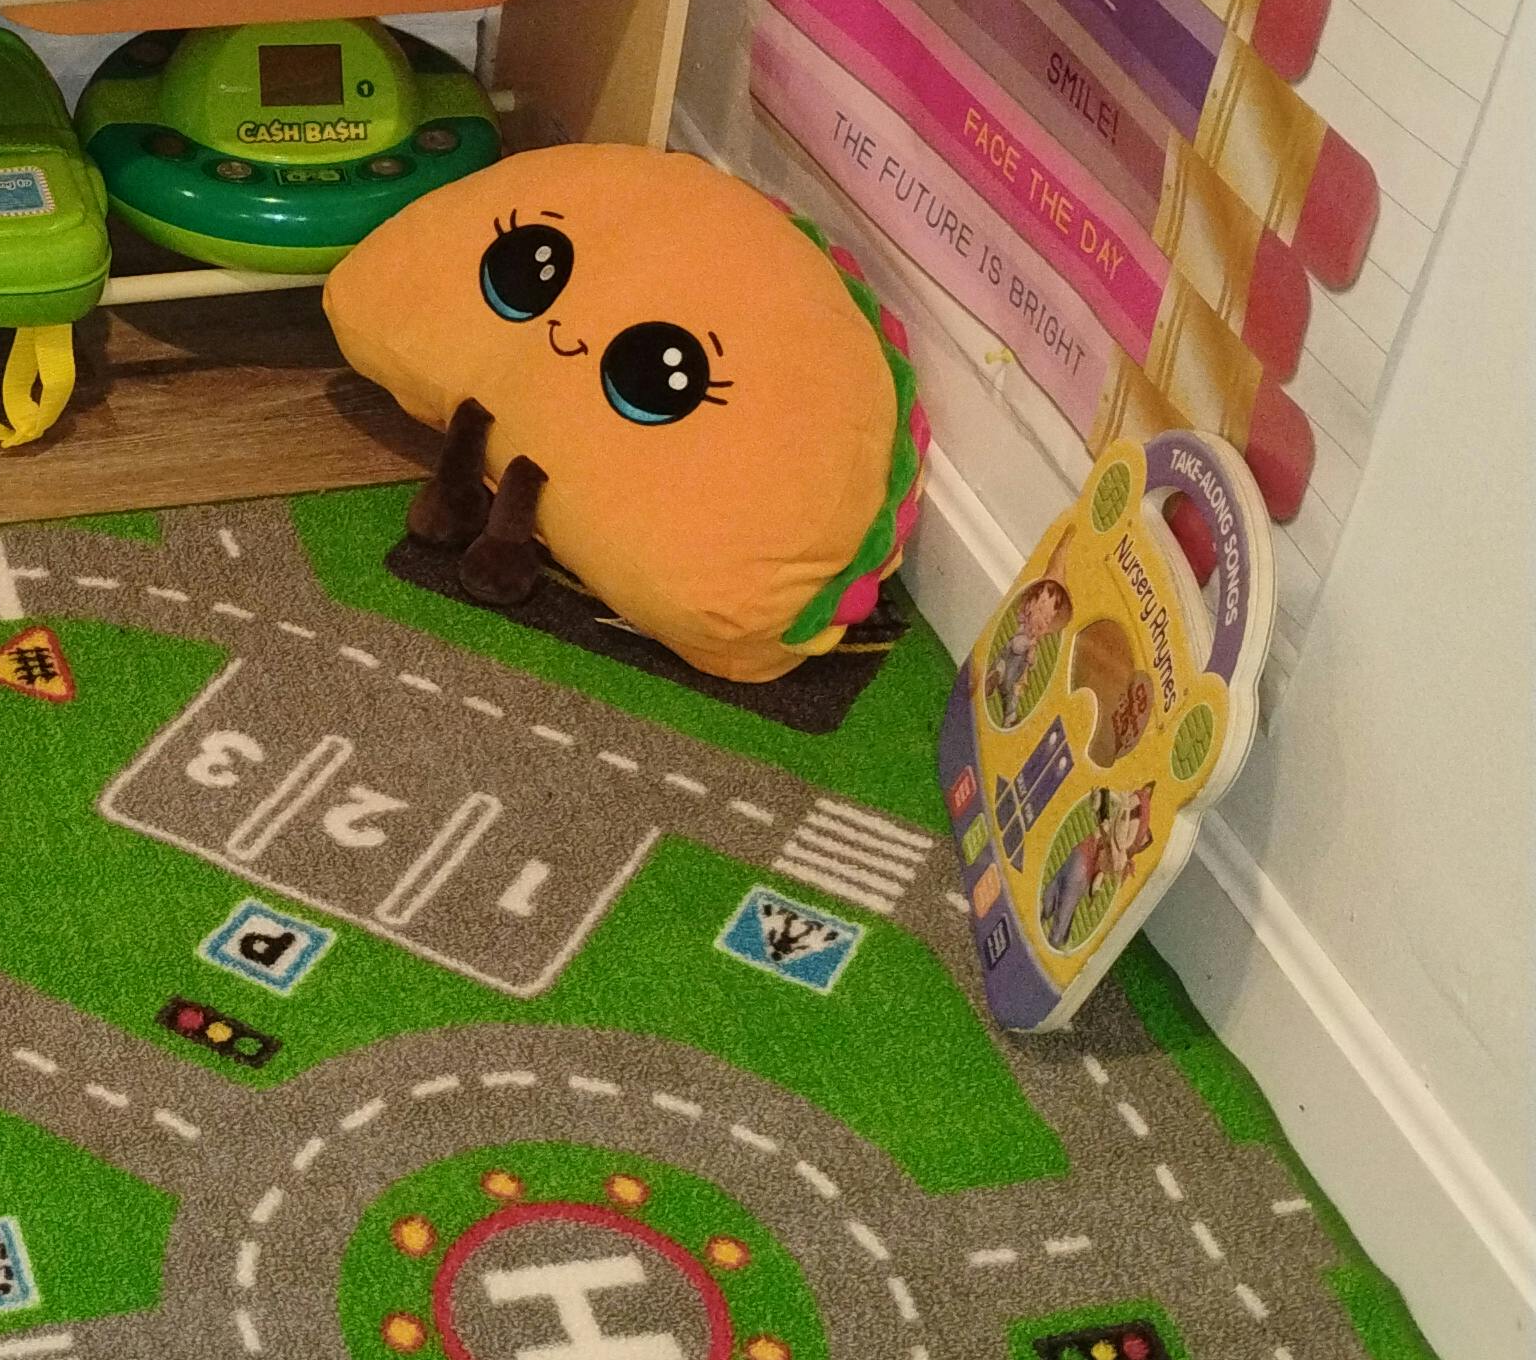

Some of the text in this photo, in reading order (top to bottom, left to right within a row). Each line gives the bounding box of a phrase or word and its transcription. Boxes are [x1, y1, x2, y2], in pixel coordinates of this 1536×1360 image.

[1046, 52, 1120, 145] SMILE!
[832, 111, 1087, 378] THE FUTURE IS BRIGHT
[963, 107, 1125, 282] FACE THE DAY
[1113, 533, 1178, 713] Nursery Rhymes
[1170, 449, 1241, 627] TAKE-ALONG SONGS
[185, 730, 263, 788] 3
[323, 785, 410, 847] 2
